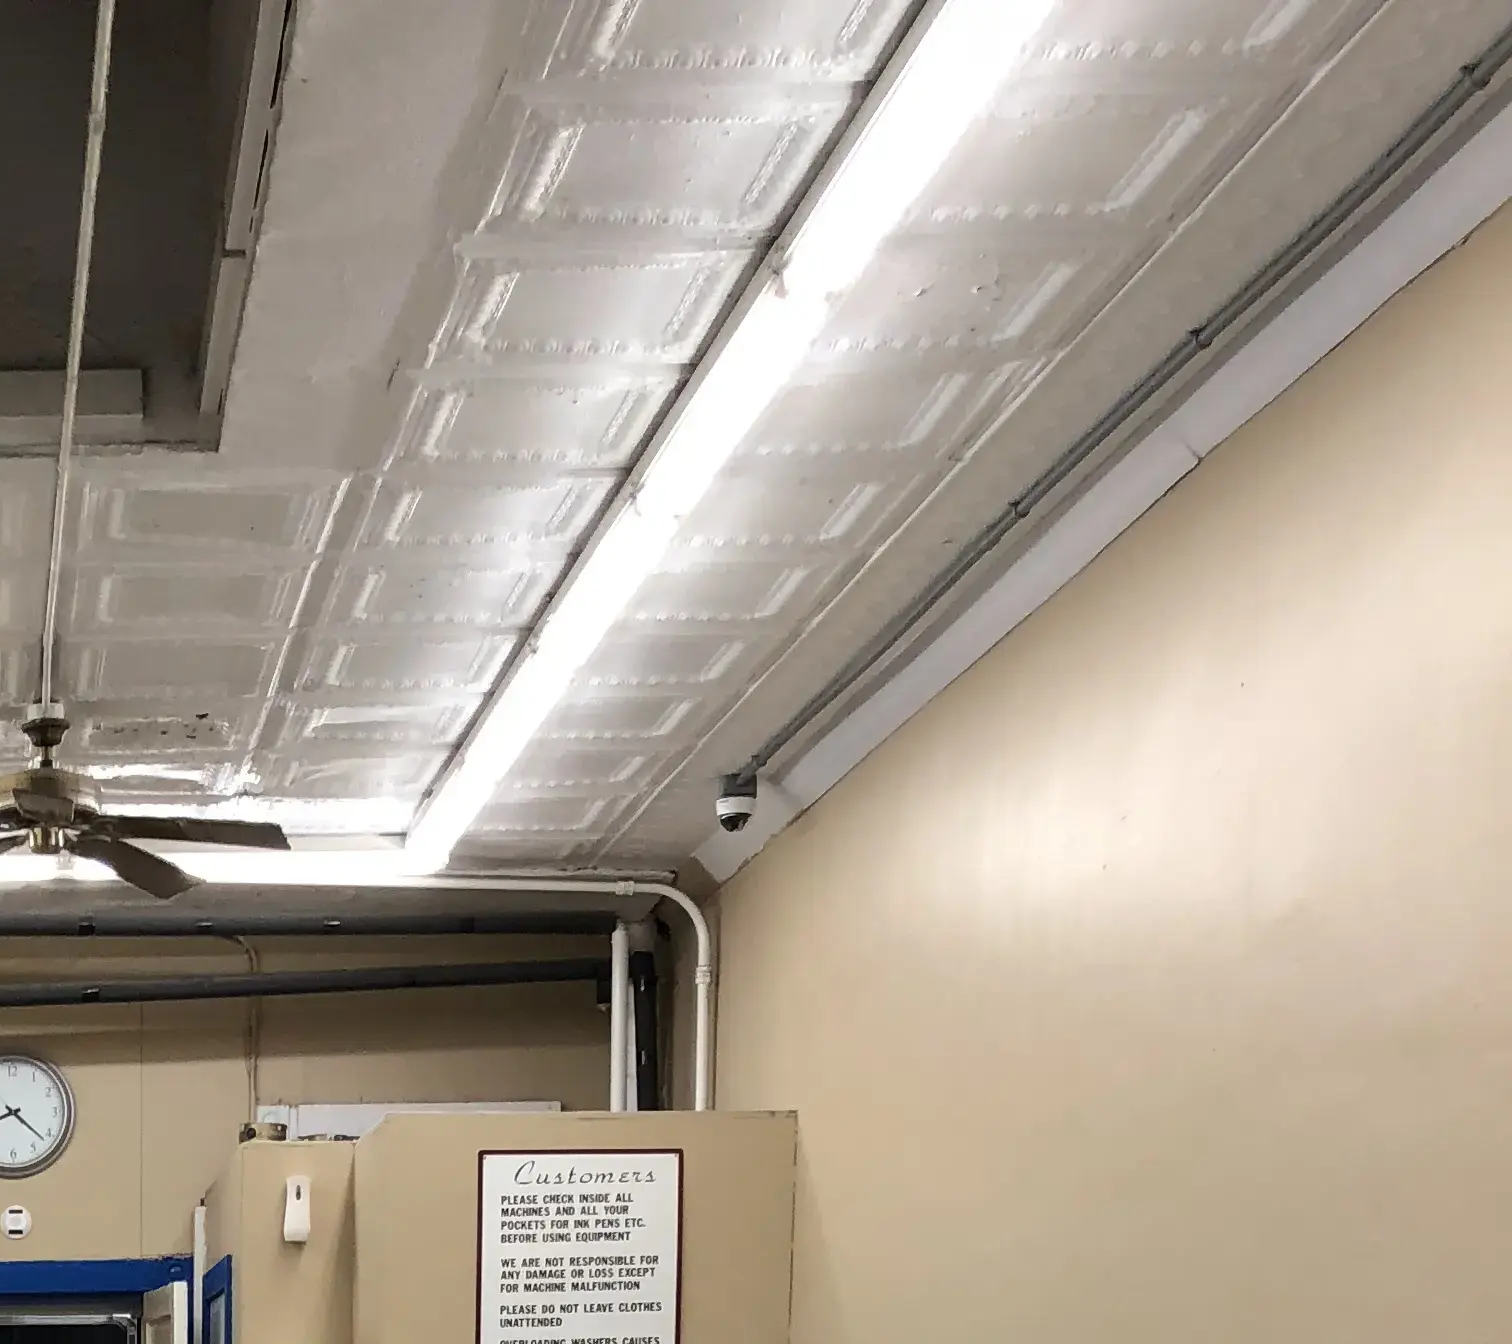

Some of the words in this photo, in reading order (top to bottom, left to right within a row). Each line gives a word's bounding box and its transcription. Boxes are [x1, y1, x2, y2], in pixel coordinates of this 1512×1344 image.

[8, 1065, 18, 1077] 12
[32, 1071, 36, 1082] 1
[45, 1087, 51, 1097] 2
[53, 1107, 57, 1118] 3
[45, 1128, 51, 1138] 4
[10, 1147, 17, 1160] 6
[30, 1141, 36, 1153] 5
[514, 1160, 656, 1184] Customers
[501, 1194, 538, 1205] PLEASE
[542, 1194, 574, 1205] CHECK
[579, 1193, 610, 1204] INSIDE
[615, 1192, 634, 1203] ALL
[501, 1206, 550, 1218] MACHINES
[555, 1206, 575, 1217] AND
[580, 1205, 598, 1216] ALL
[604, 1204, 629, 1215] YOUR
[501, 1219, 546, 1231] POCKETS
[550, 1219, 569, 1230] FOR
[573, 1219, 590, 1229] INK
[595, 1218, 620, 1229] PENS
[625, 1217, 646, 1228] ETC.
[500, 1233, 538, 1244] BEFORE
[542, 1232, 571, 1243] USING
[575, 1231, 631, 1242] EQUIPMENT
[501, 1258, 516, 1268] WE
[521, 1257, 541, 1268] ARE
[545, 1257, 564, 1267] NOT
[569, 1255, 636, 1267] RESPONSIBLE
[640, 1254, 659, 1265] FOR
[500, 1270, 521, 1280] ANY
[525, 1269, 566, 1280] DAMAGE
[570, 1268, 584, 1279] OR
[589, 1267, 614, 1279] LOSS
[618, 1267, 656, 1278] EXCEPT
[500, 1283, 519, 1294] FOR
[523, 1282, 566, 1293] MACHINE
[571, 1280, 640, 1292] MALFUNCTION
[500, 1304, 537, 1315] PLEASE
[541, 1304, 555, 1315] DO
[559, 1303, 579, 1314] NOT
[583, 1302, 614, 1313] LEAVE
[618, 1301, 662, 1313] CLOTHES
[500, 1317, 563, 1328] UNATTENDED
